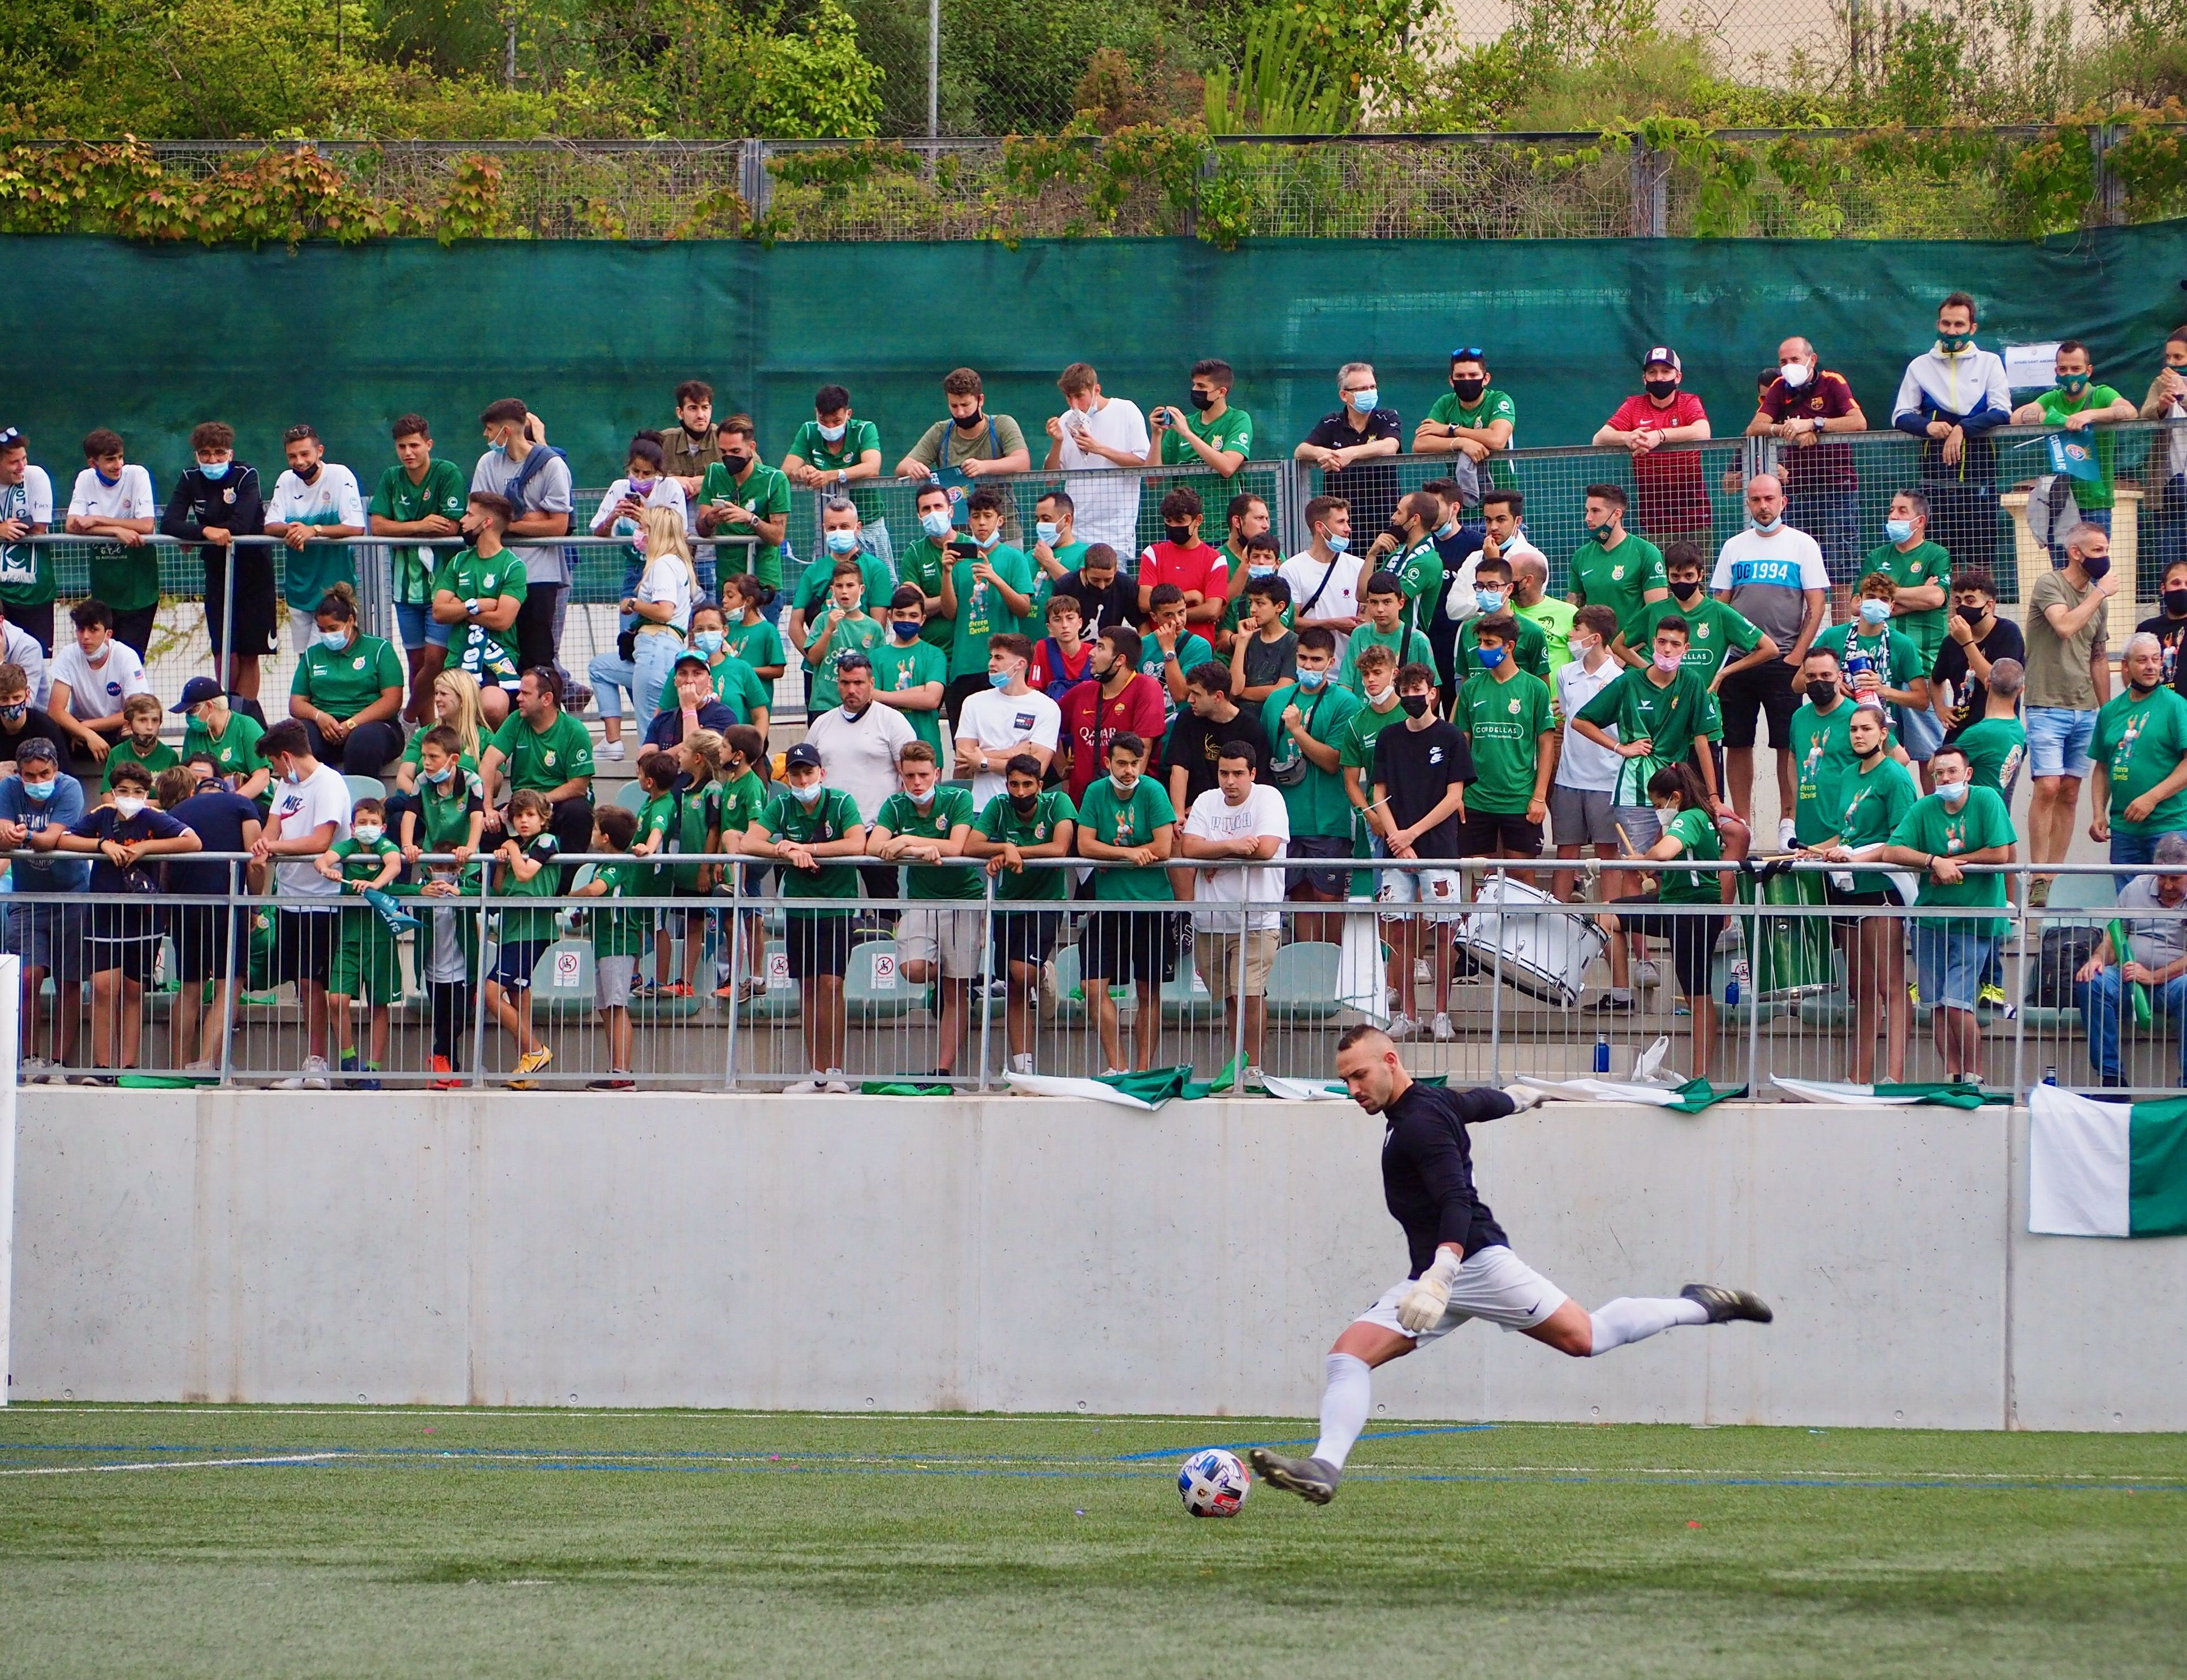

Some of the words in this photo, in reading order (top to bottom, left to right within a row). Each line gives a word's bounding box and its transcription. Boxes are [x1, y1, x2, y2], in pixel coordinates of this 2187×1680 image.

[1752, 562, 1788, 580] 1994
[968, 619, 988, 628] Green
[969, 626, 990, 635] Devils
[1079, 727, 1117, 741] QAAR
[282, 794, 303, 811] NIKE
[1210, 811, 1252, 832] PUMA
